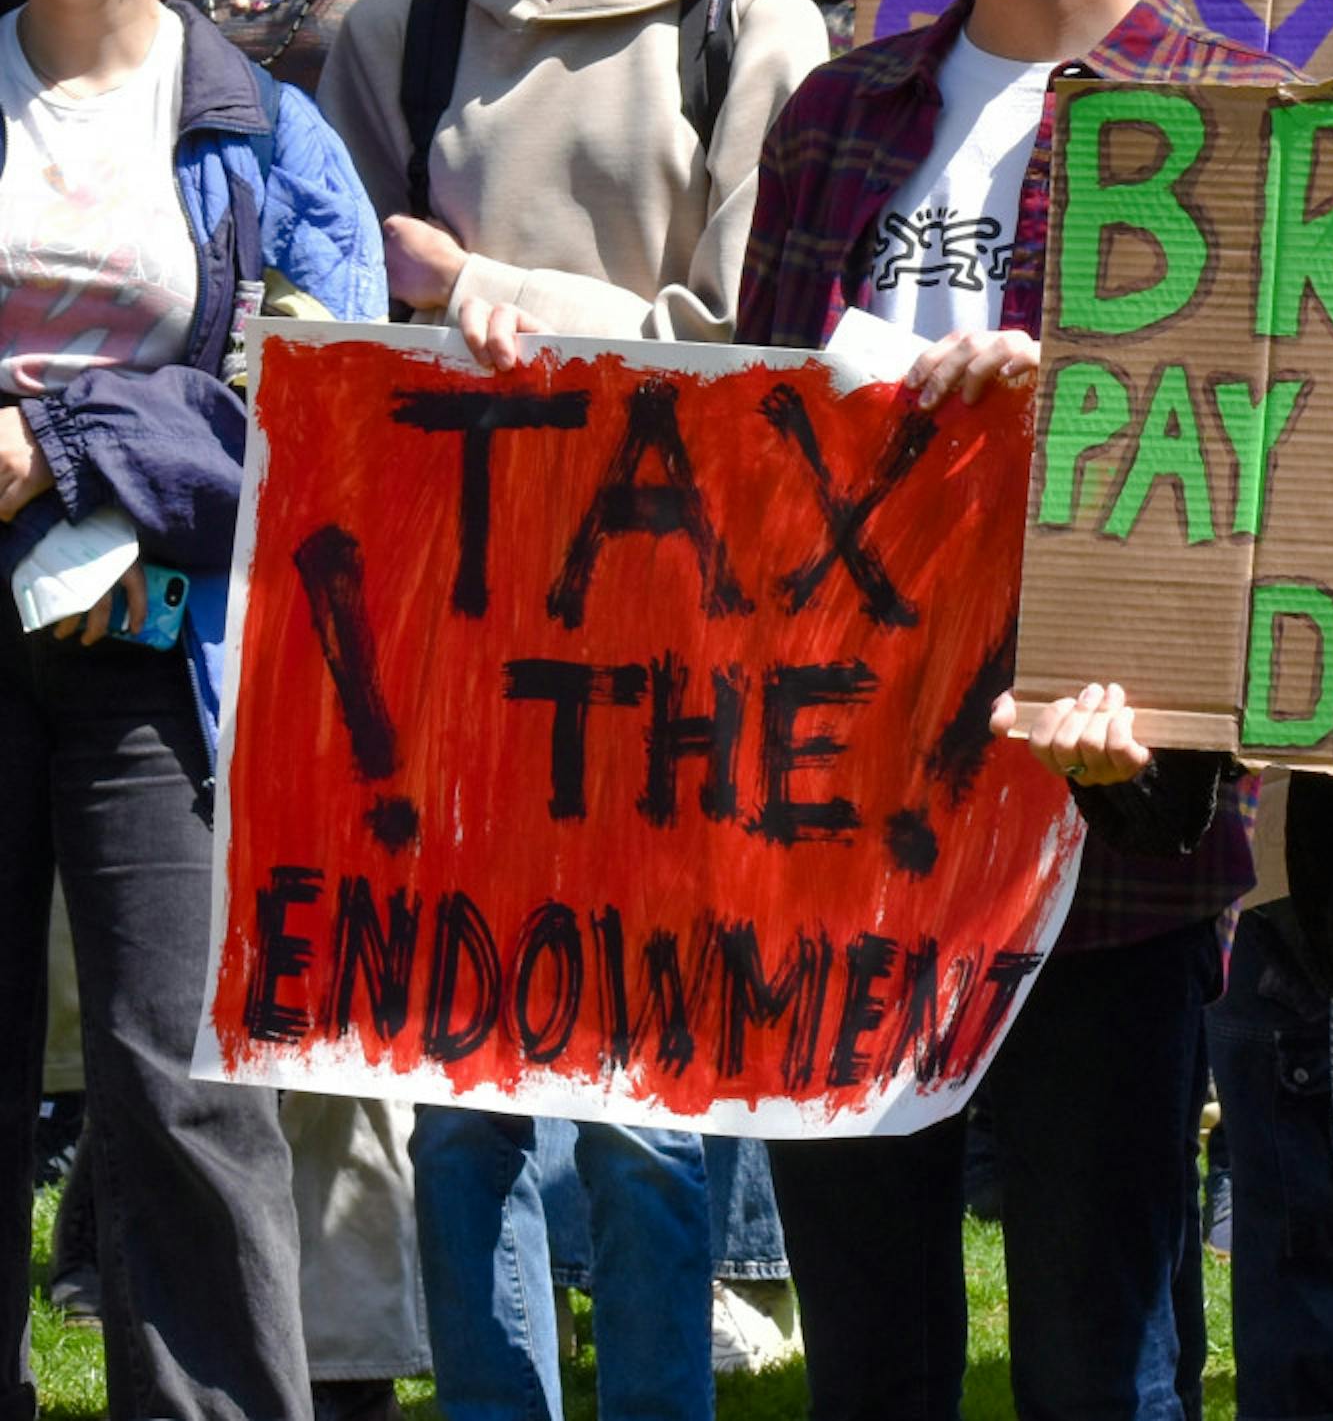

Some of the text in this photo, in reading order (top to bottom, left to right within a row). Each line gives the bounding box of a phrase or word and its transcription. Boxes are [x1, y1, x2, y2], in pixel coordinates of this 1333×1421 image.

[390, 380, 939, 629] TAX
[1033, 359, 1312, 544] PAY
[243, 865, 1044, 1095] ENDOWMENT
